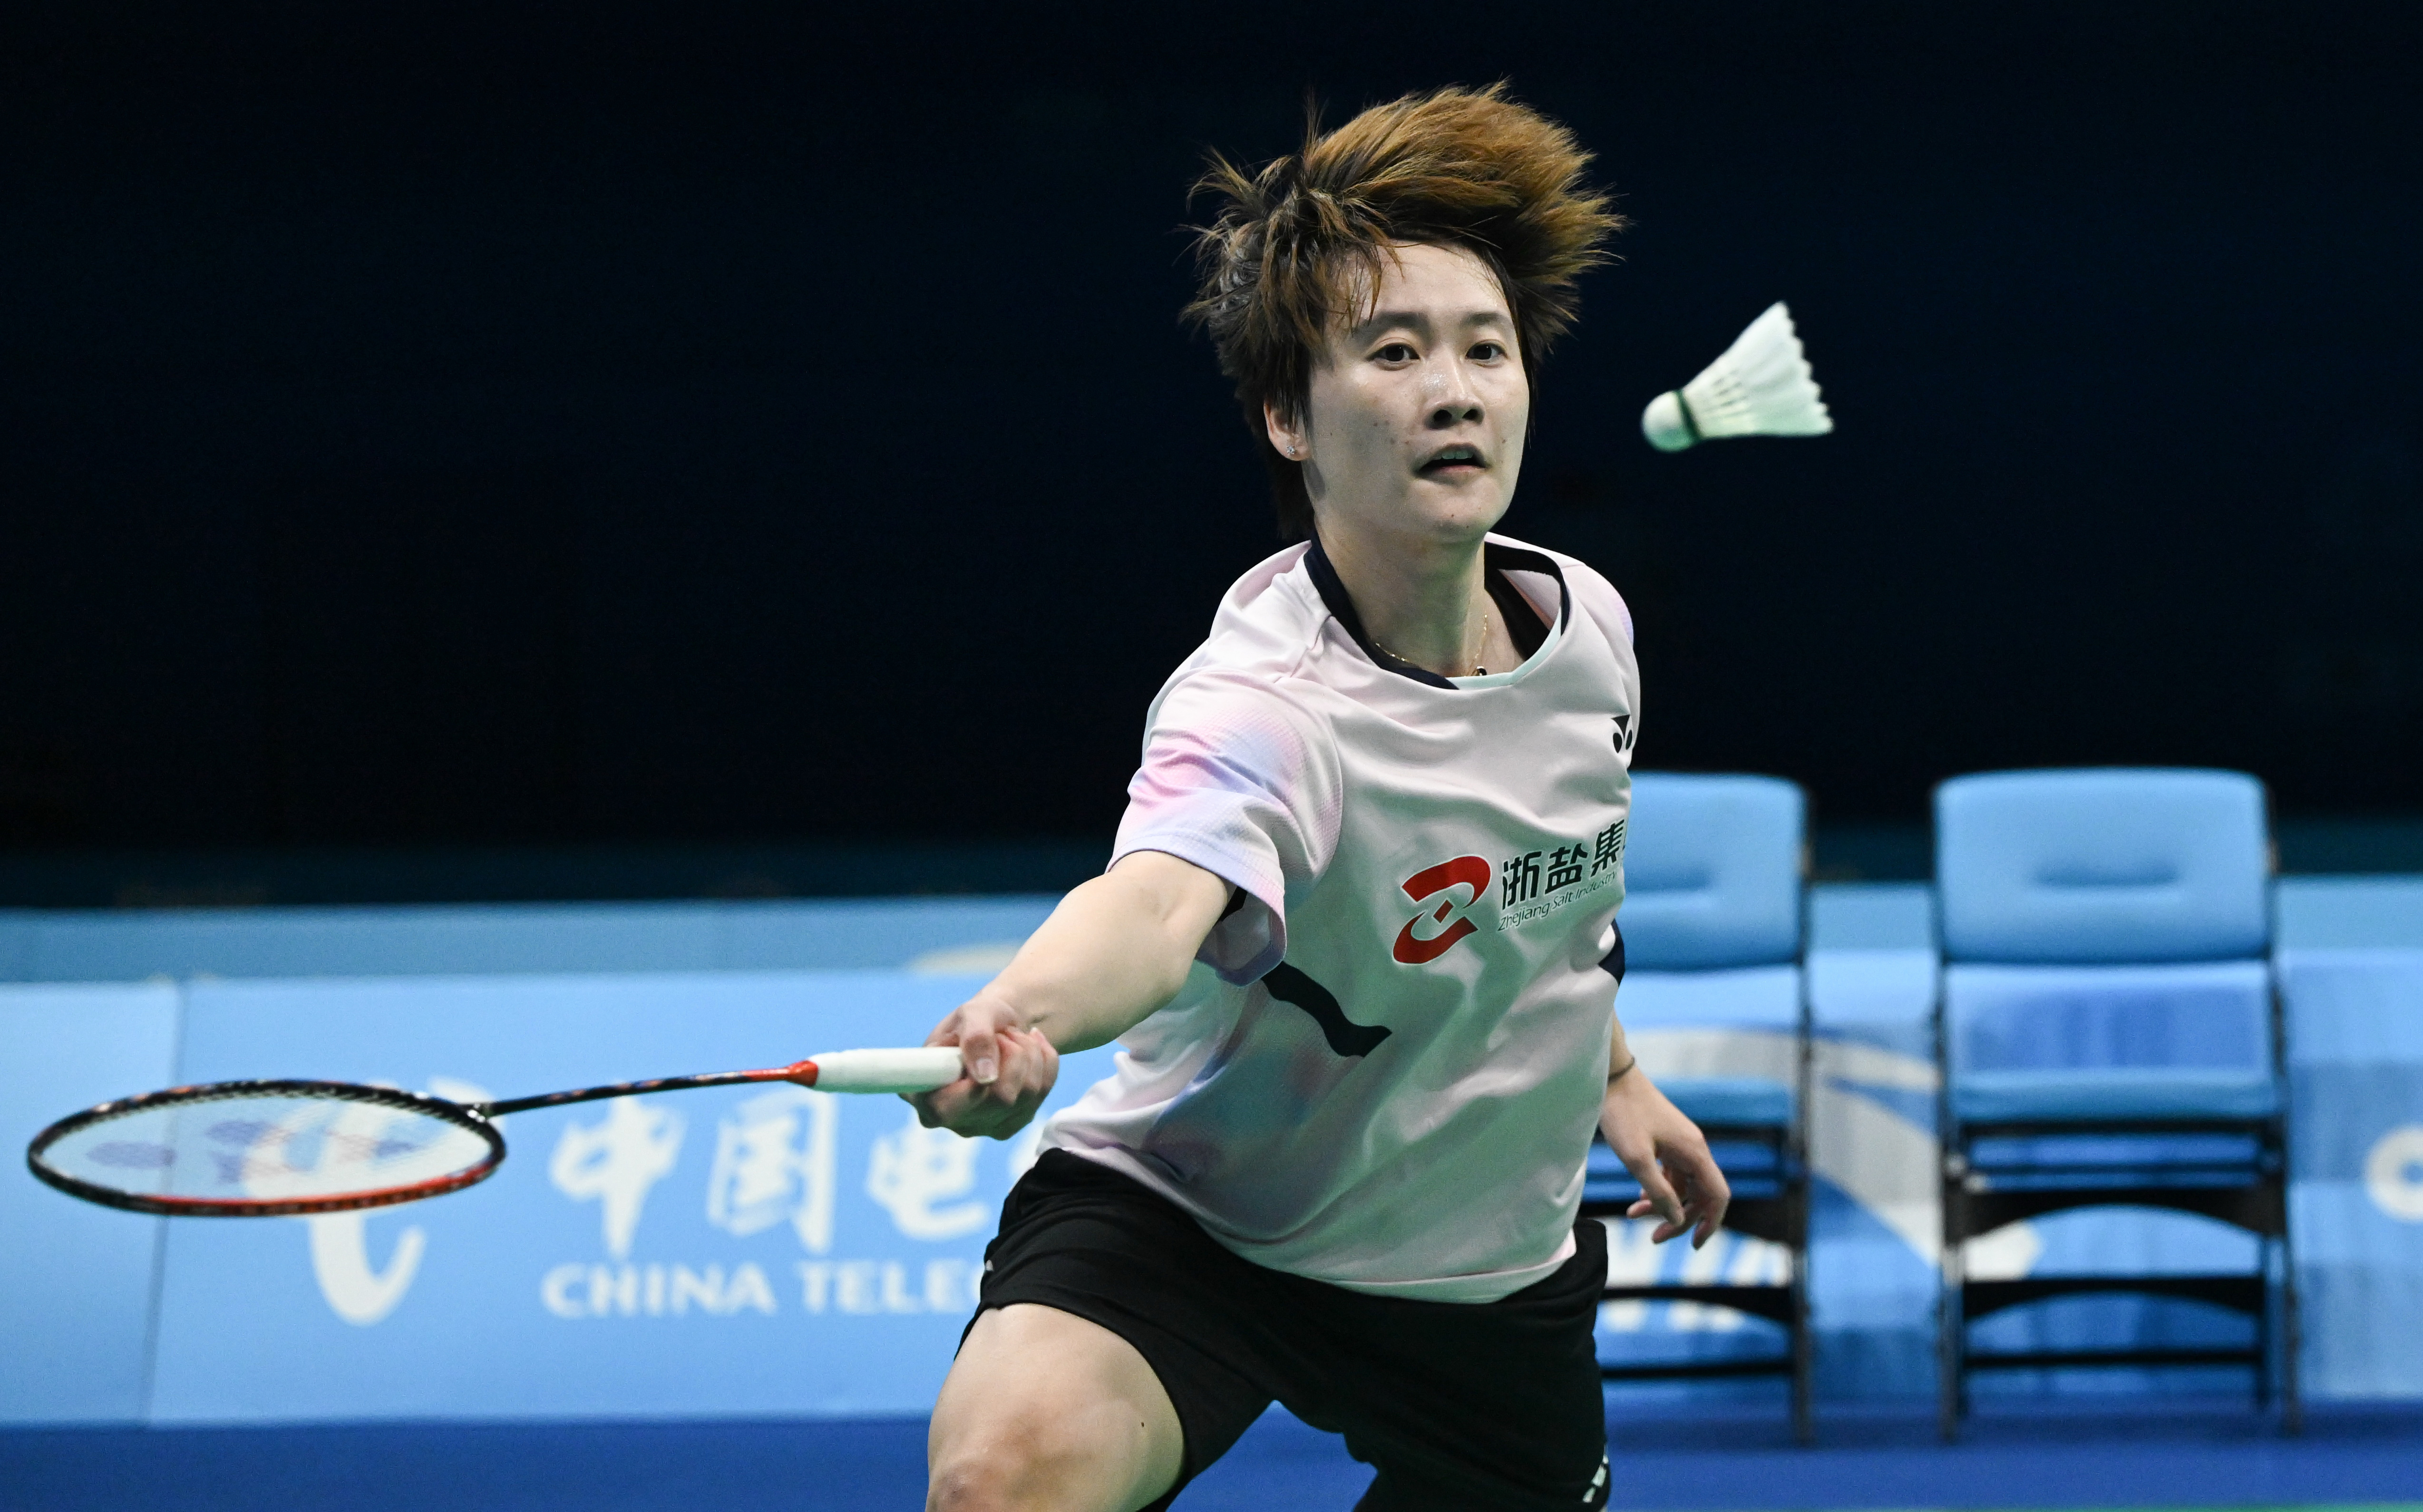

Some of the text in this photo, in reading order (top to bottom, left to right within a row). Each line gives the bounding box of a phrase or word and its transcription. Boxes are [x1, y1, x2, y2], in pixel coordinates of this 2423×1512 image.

[1498, 871, 1616, 931] Zhejiang Salt Industry
[1502, 819, 1625, 911] 浙盐集
[548, 1083, 1046, 1258] 中国电
[541, 1259, 983, 1318] CHINA TELE
